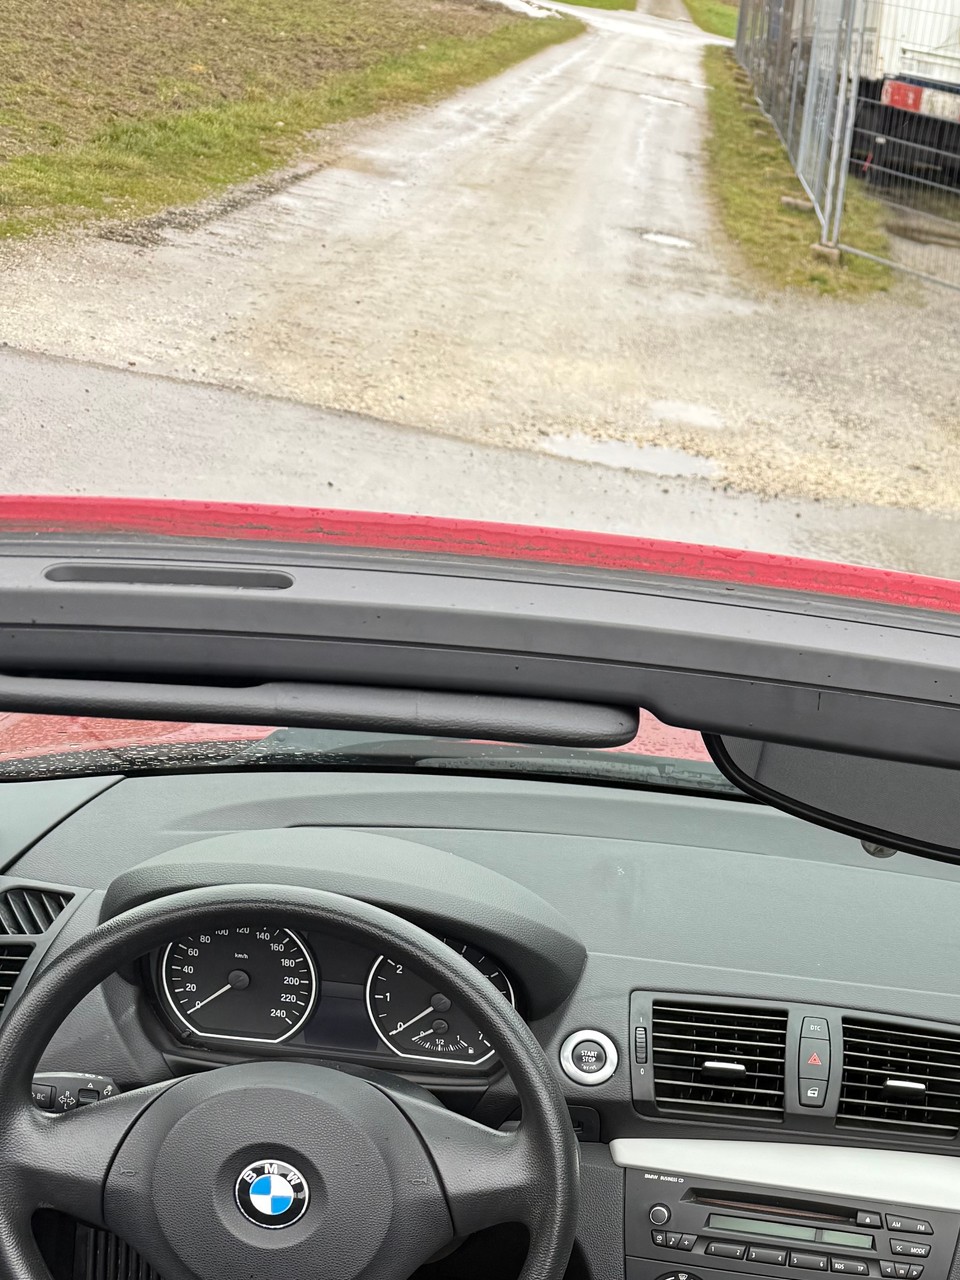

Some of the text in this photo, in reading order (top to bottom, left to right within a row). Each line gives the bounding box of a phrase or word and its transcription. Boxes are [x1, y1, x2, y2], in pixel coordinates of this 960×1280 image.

[199, 934, 211, 944] 80
[255, 931, 271, 941] 140
[187, 947, 199, 957] 60
[269, 942, 285, 952] 160
[280, 958, 296, 968] 180
[182, 965, 194, 974] 40
[396, 964, 403, 974] 2
[283, 976, 300, 986] 200
[185, 983, 197, 992] 20
[280, 993, 297, 1003] 220
[270, 1008, 287, 1019] 240
[810, 1024, 821, 1032] DTC
[36, 1092, 46, 1101] BC
[243, 1163, 301, 1186] BMW
